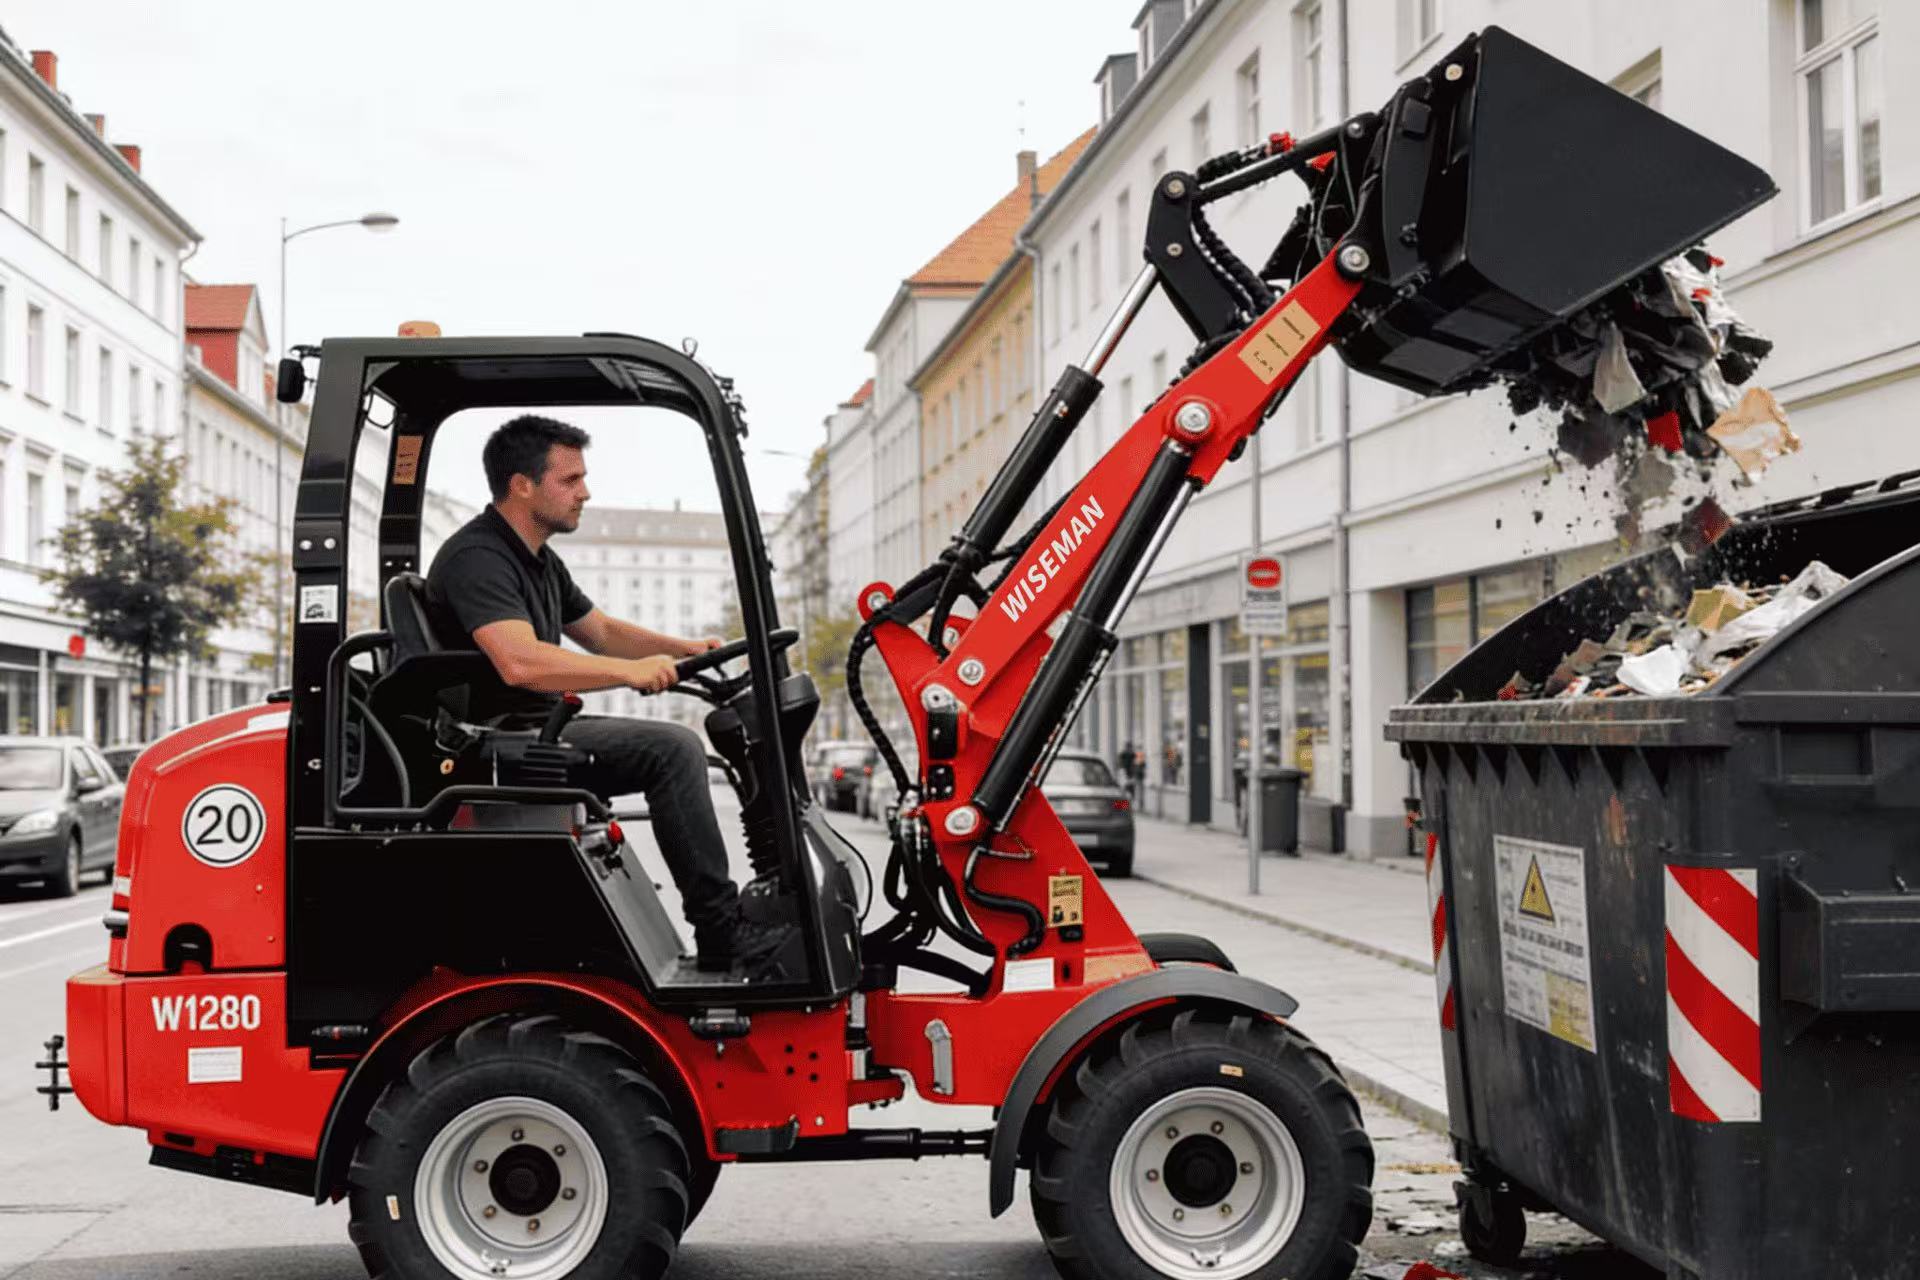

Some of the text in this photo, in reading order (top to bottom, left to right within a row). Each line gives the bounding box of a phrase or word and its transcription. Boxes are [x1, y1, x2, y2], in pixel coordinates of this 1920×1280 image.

[1000, 495, 1105, 623] WISEMAN
[196, 804, 252, 845] 20
[151, 993, 261, 1032] W1280
